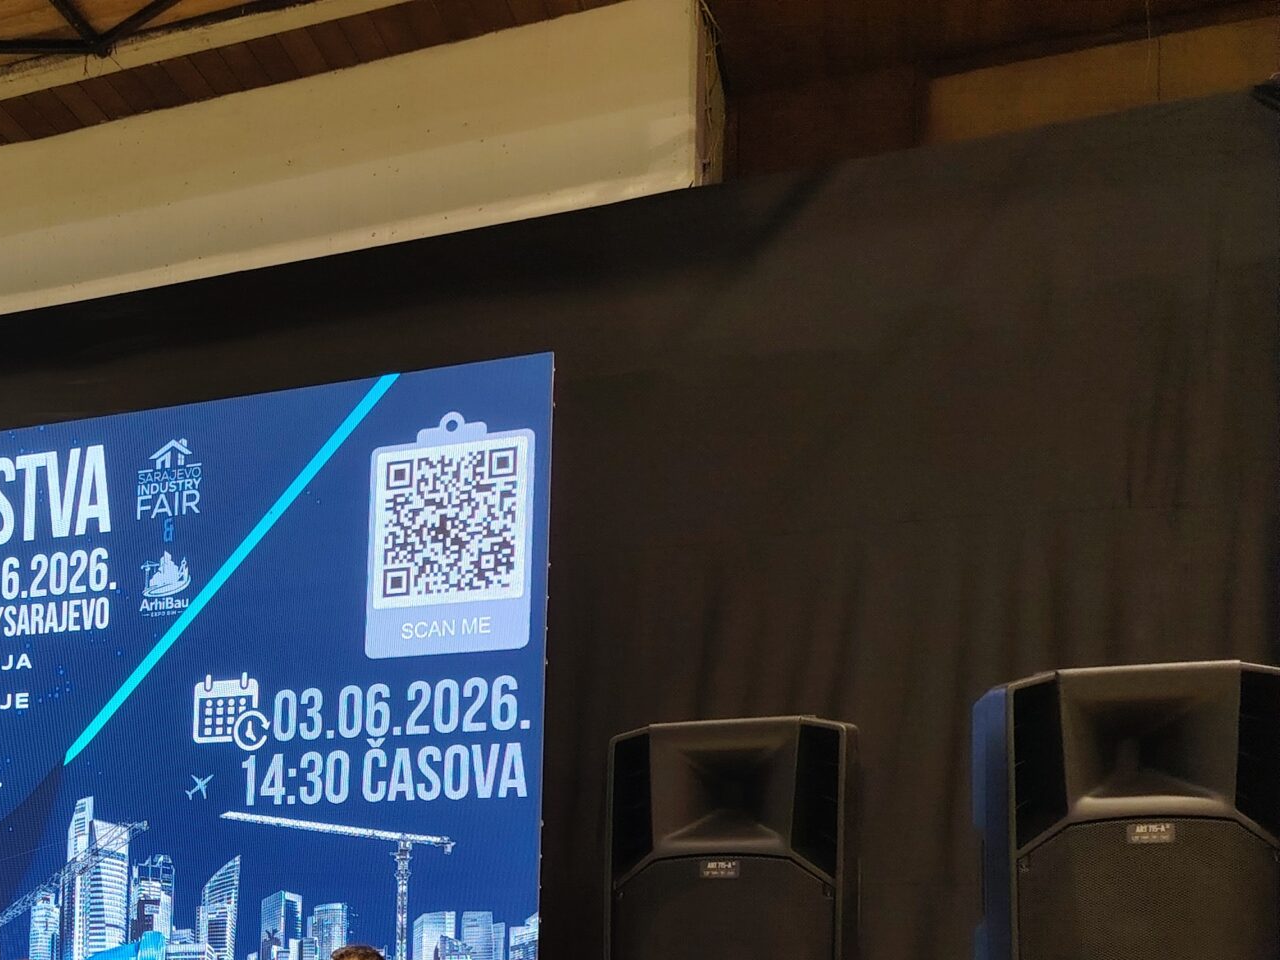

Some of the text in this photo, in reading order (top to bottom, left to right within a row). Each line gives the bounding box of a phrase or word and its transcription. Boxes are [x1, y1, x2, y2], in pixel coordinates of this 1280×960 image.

[137, 477, 202, 496] INDUSTRY
[138, 467, 201, 485] SARAJEVO
[136, 490, 200, 520] FAIR
[139, 597, 189, 612] ArhiBau
[401, 616, 491, 640] SCAN ME
[273, 675, 530, 742] 03.06.2026.
[242, 738, 528, 806] 14:30 ČASOVA
